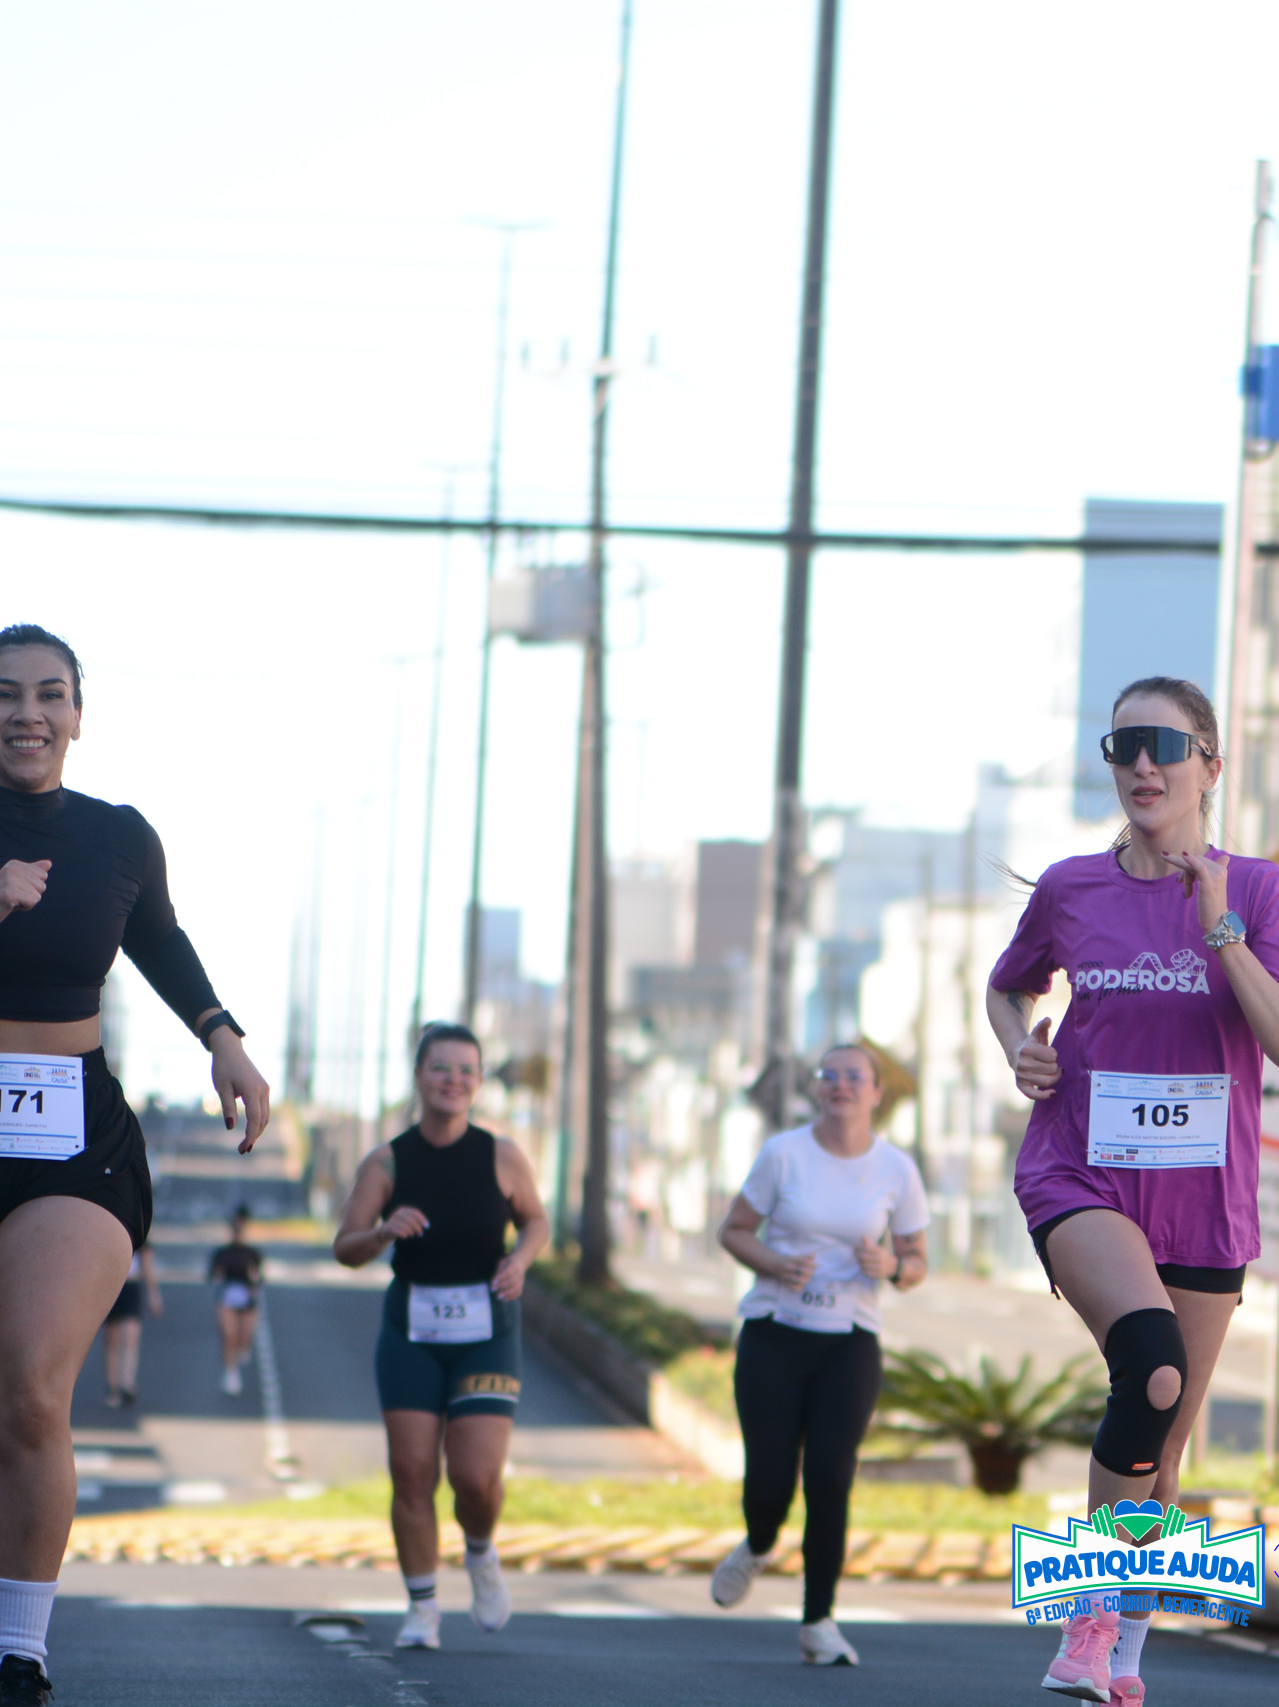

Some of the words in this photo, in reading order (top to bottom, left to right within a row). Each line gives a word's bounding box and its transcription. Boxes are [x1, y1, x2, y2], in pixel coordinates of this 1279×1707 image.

[1075, 968, 1211, 995] PODEROSA
[0, 1088, 43, 1115] 71
[1132, 1103, 1190, 1127] 105
[433, 1305, 466, 1319] 123
